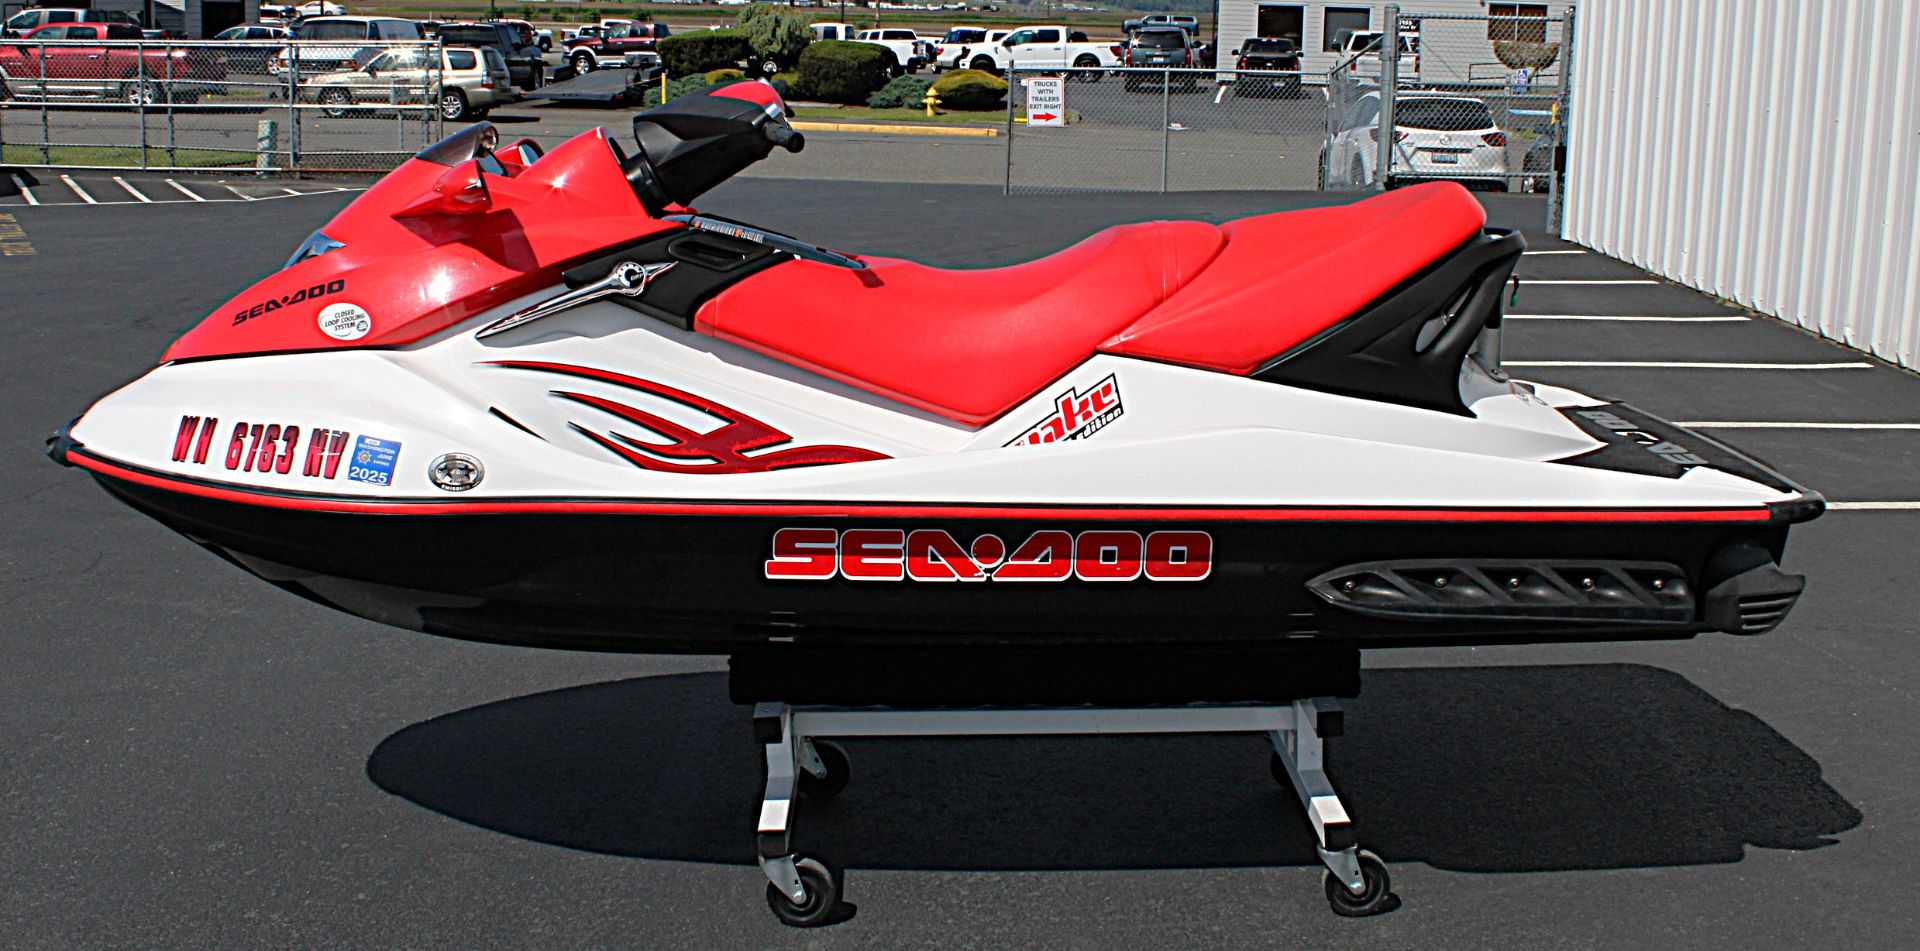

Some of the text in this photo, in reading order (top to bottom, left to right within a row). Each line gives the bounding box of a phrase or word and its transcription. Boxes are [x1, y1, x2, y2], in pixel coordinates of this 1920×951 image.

[334, 309, 355, 318] CLOSED
[325, 313, 366, 327] LOOP COOLING
[334, 321, 356, 331] SYSTEM
[172, 415, 350, 480] WN 6763 NV
[358, 443, 396, 454] WASHINGTON
[377, 453, 393, 461] JUNE
[350, 466, 389, 483] 2025
